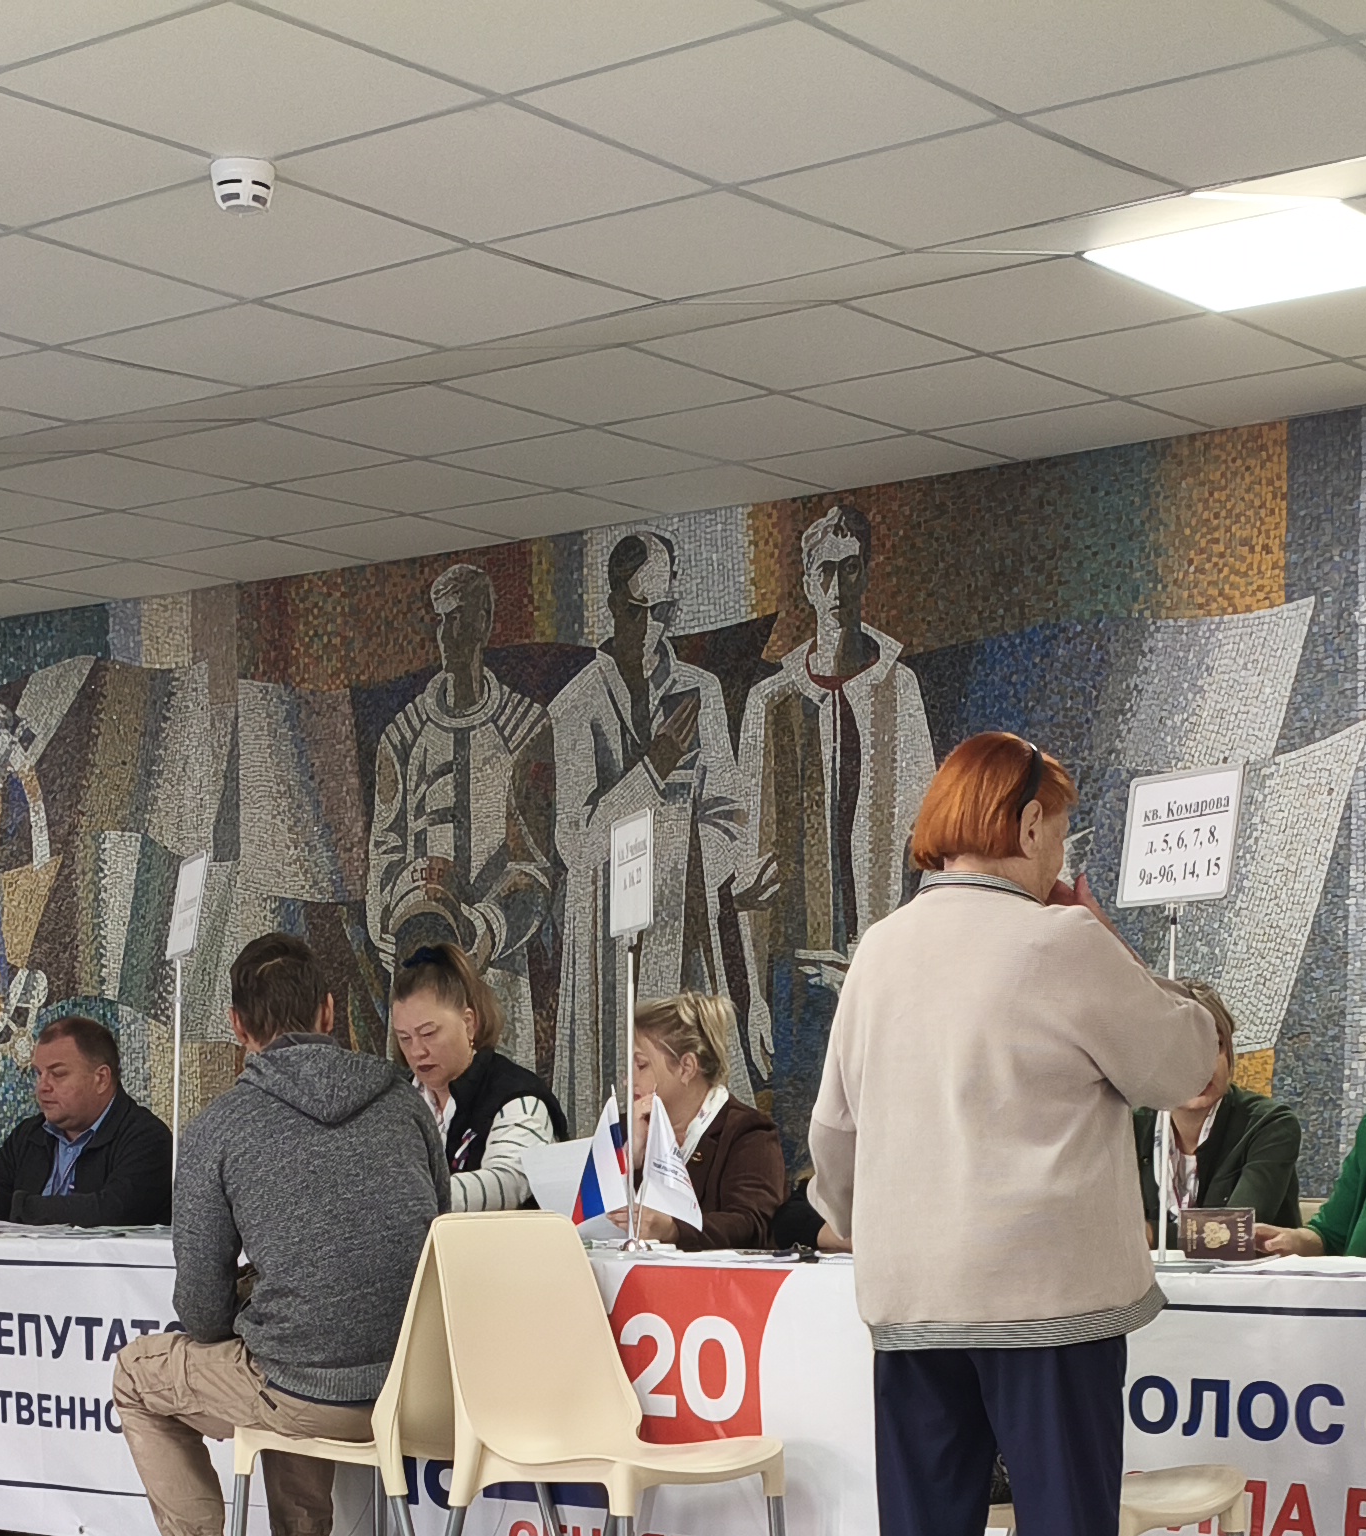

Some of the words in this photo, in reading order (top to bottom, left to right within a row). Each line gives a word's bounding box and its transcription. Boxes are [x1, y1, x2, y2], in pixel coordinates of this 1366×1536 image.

[1143, 808, 1162, 822] кв.
[1166, 795, 1230, 819] Комарова
[1161, 833, 1173, 855] 5,
[1176, 830, 1188, 852] 6,
[1193, 828, 1203, 850] 7,
[1207, 825, 1219, 847] 8,
[1182, 860, 1200, 882] 14,
[1206, 857, 1221, 877] 15
[619, 1312, 747, 1423] 20
[1128, 1375, 1346, 1445] ОЛОС
